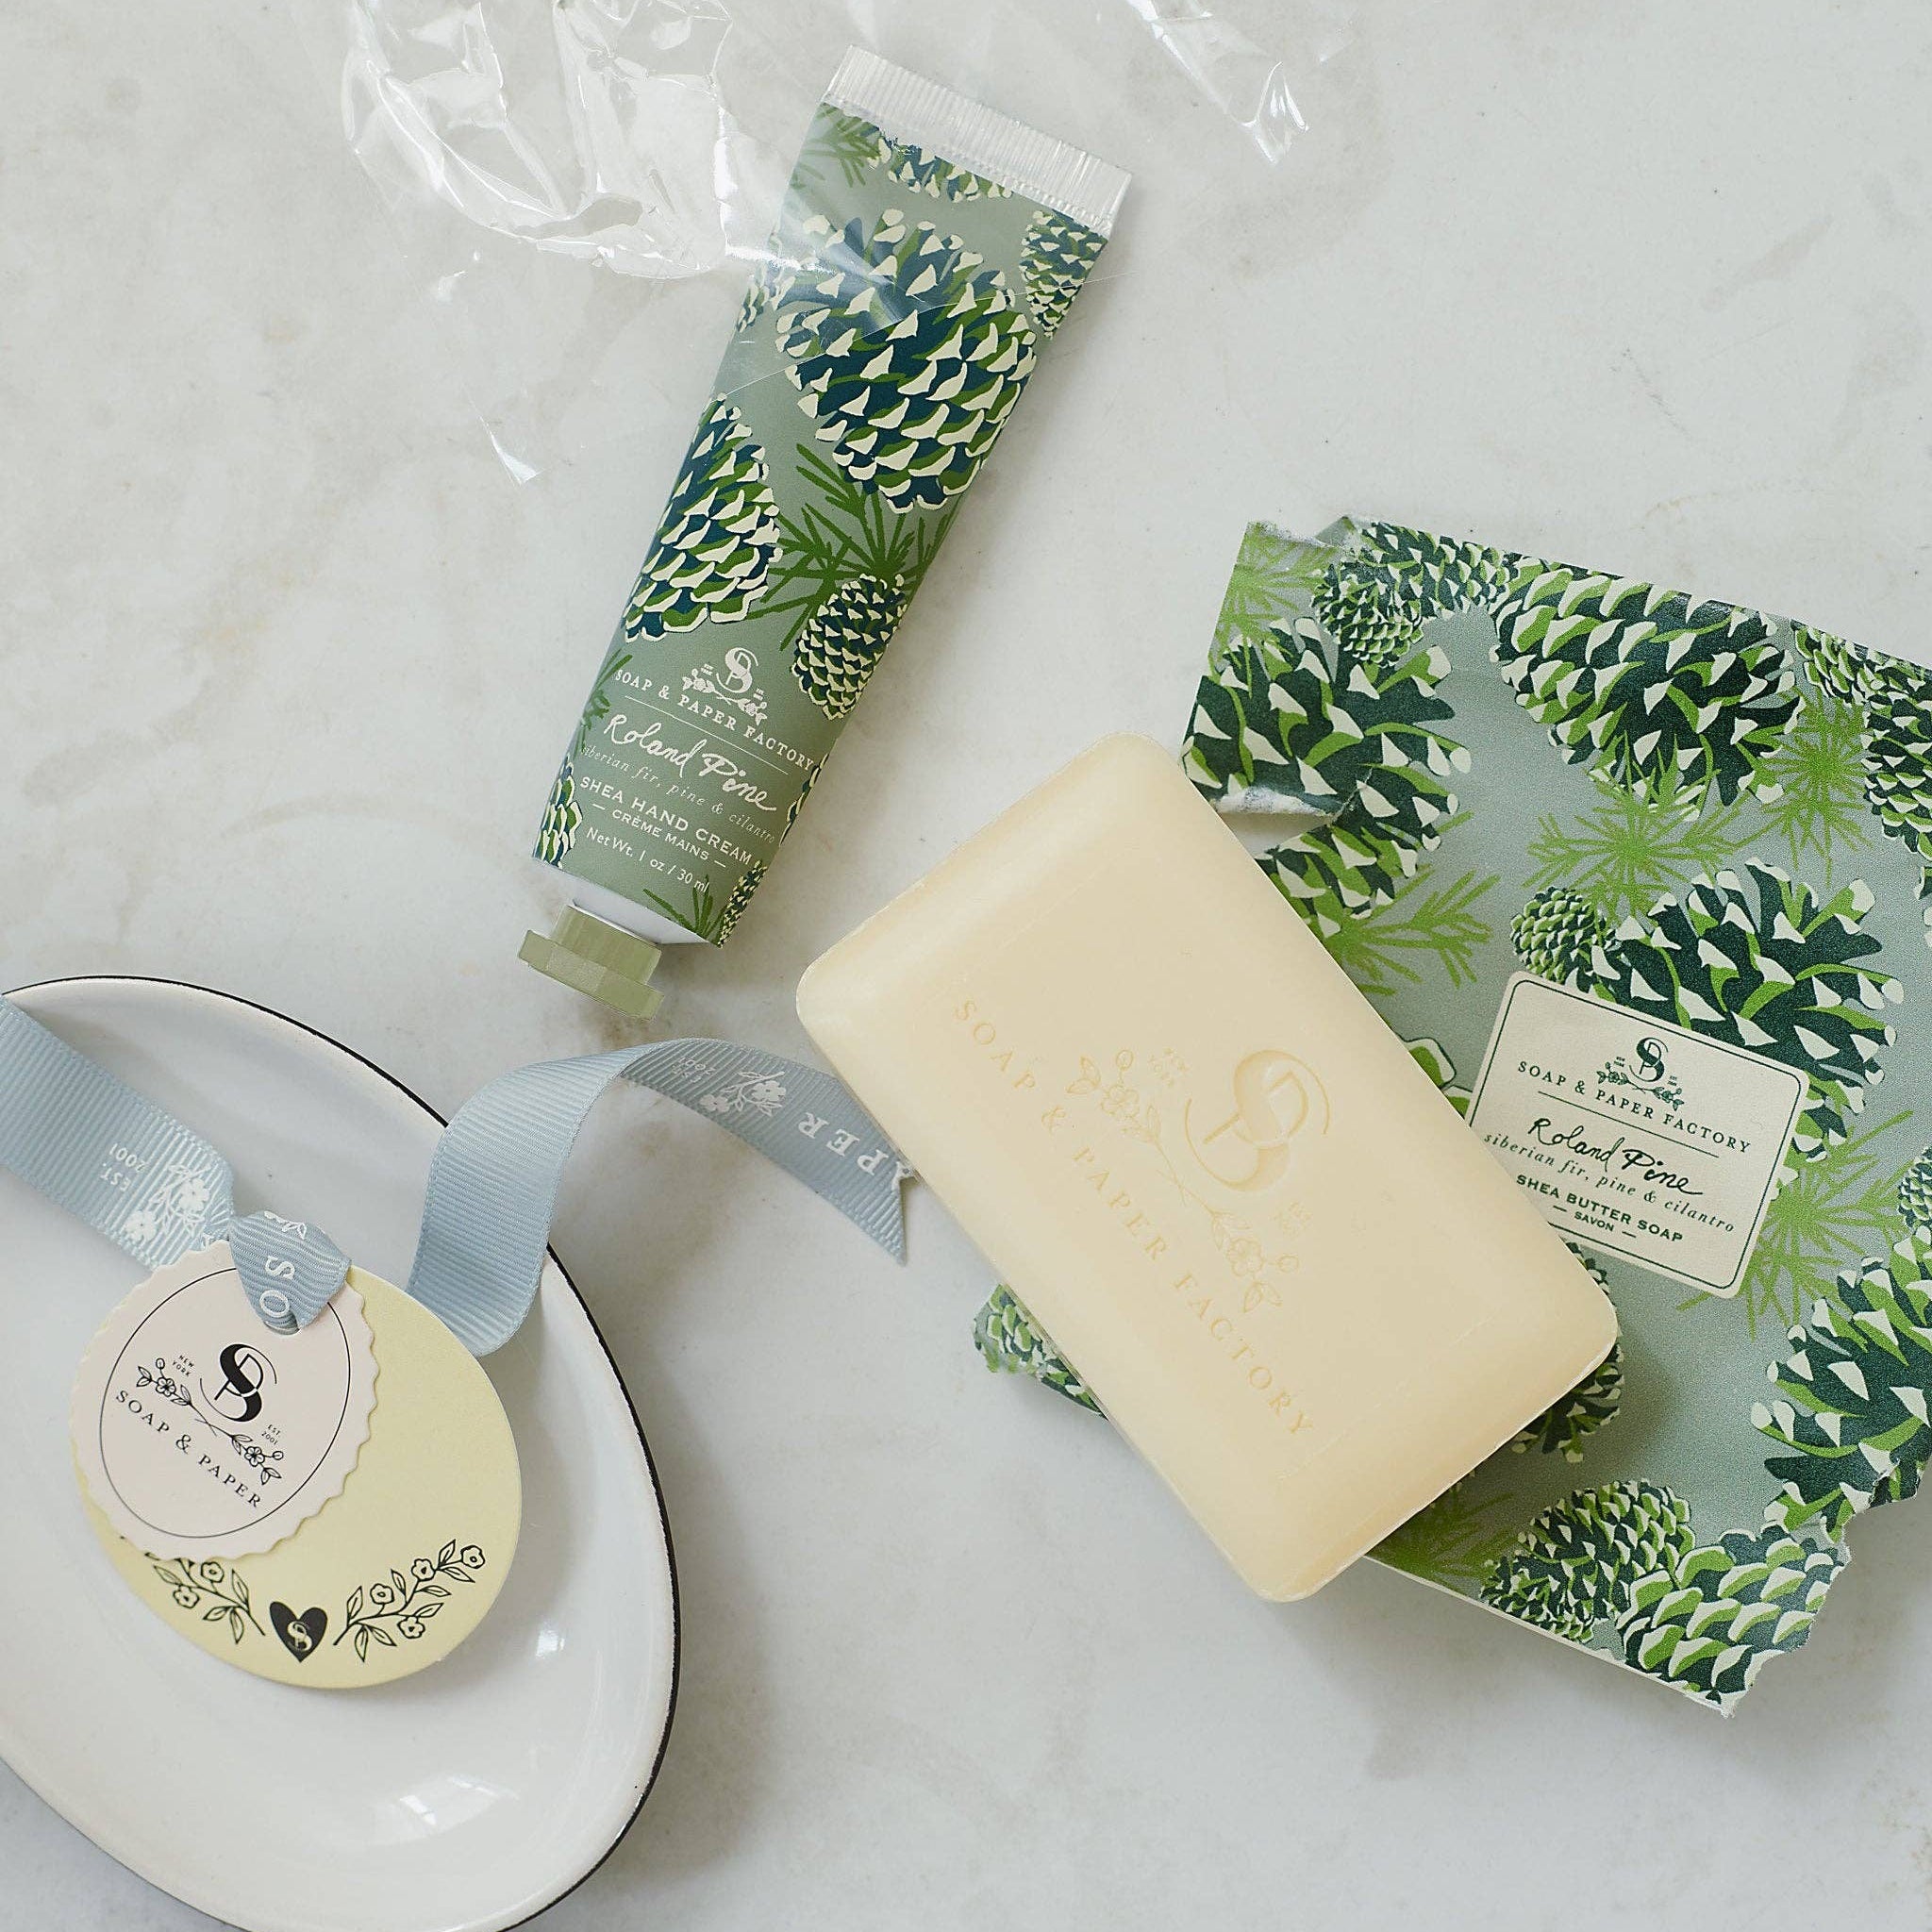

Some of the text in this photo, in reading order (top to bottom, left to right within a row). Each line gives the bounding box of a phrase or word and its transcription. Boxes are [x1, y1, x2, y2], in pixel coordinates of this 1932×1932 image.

[615, 669, 653, 691] SOAP
[658, 685, 671, 700] &
[677, 694, 738, 731] PAPER
[742, 724, 814, 772] FACTORY
[604, 714, 776, 811] Roland Pine
[579, 776, 753, 865] SHEA HAND CREAM
[631, 766, 661, 788] fir,
[665, 784, 707, 806] pine
[710, 802, 724, 815] &
[728, 814, 775, 843] cilantro
[586, 826, 612, 846] Net
[612, 837, 634, 858] Wt.
[650, 858, 666, 872] oz
[677, 868, 693, 885] 30
[693, 879, 710, 893] ml
[664, 832, 709, 860] MAINS
[1517, 1060, 1752, 1154] SOAP & PAPER FACTORY
[100, 1162, 132, 1192] EST.
[108, 1142, 147, 1173] 2001
[1484, 1133, 1736, 1233] siberian fir, pine & cilantro
[1527, 1118, 1704, 1195] Roland Pine
[955, 999, 1036, 1091] SOAP
[1041, 1106, 1068, 1134] &
[1072, 1146, 1170, 1261] PAPER
[1173, 1272, 1313, 1435] FACTORY
[1516, 1174, 1684, 1242] SHEA BUTTER SOAP
[1574, 1210, 1615, 1232] SAVON
[115, 1390, 262, 1508] SOAP & PAPER
